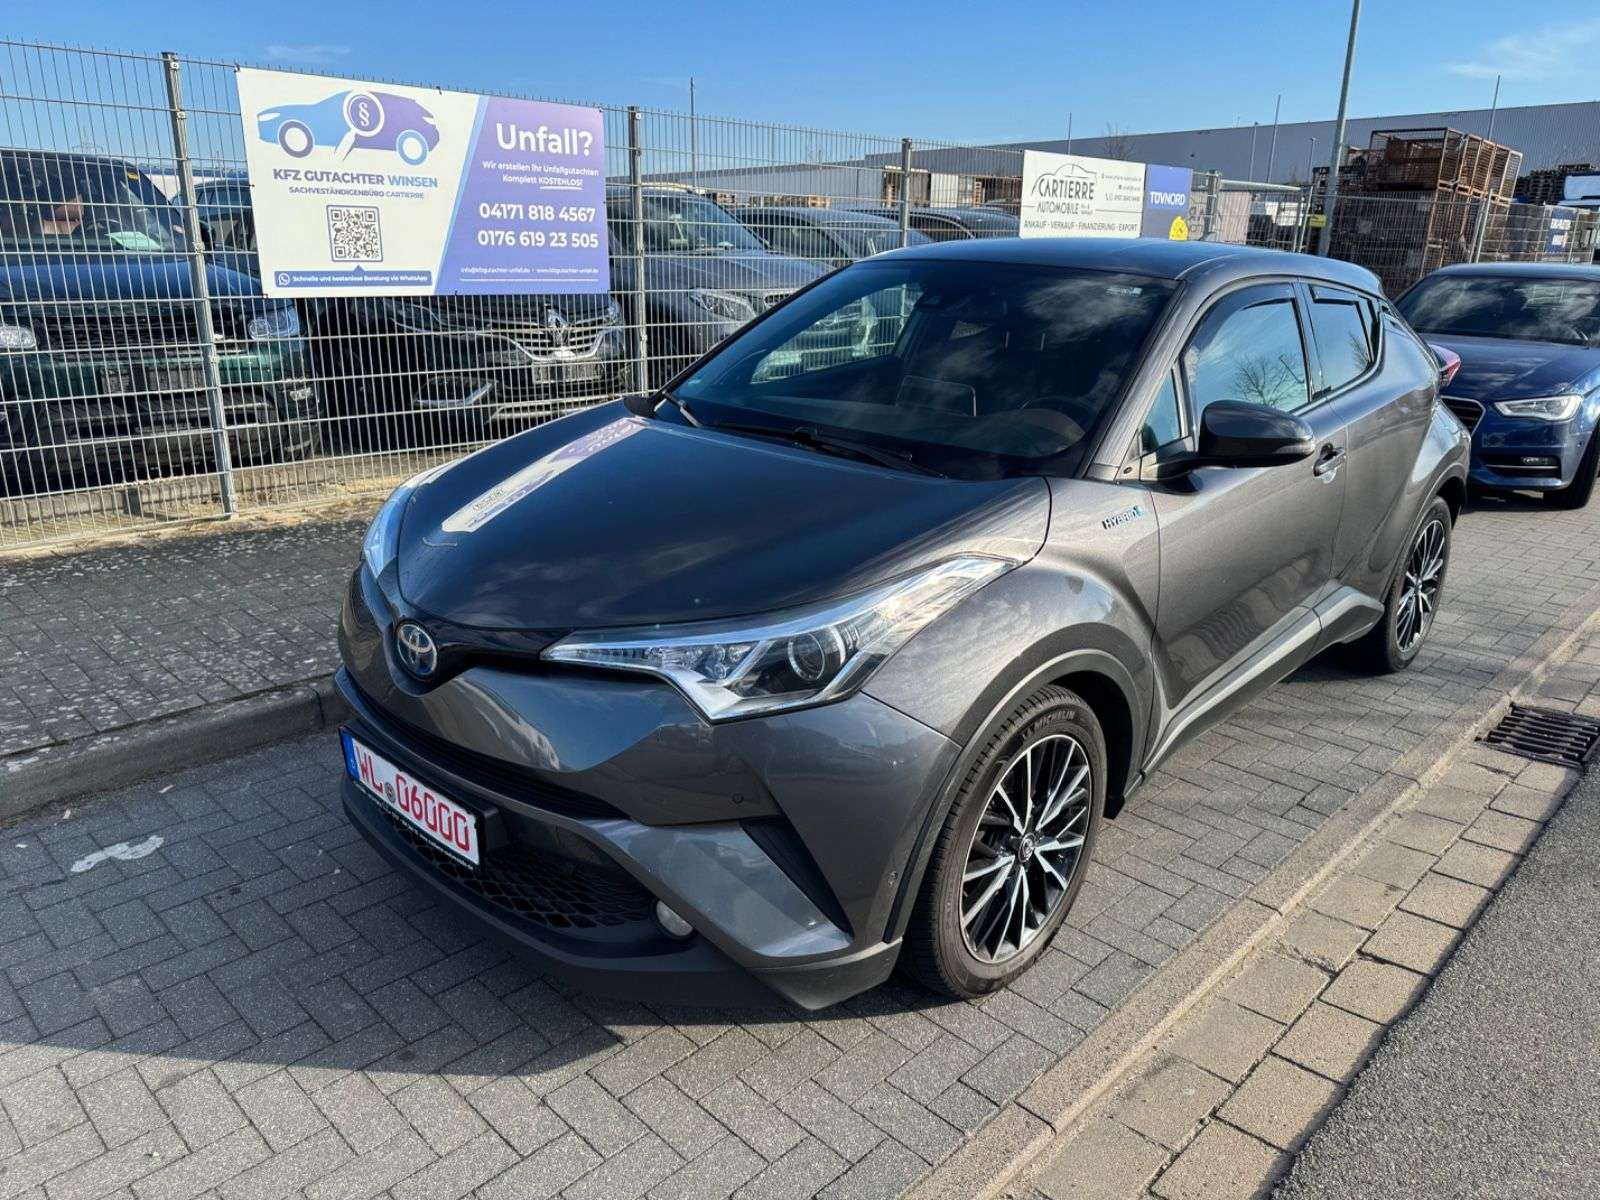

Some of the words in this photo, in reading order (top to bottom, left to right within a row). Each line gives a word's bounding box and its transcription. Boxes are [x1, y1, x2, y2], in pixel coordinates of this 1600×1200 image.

[496, 122, 593, 157] Unfall?
[482, 160, 496, 169] Wir
[498, 162, 530, 172] erstellen
[543, 165, 599, 176] Unfallgutachten
[273, 168, 301, 182] KFZ
[304, 171, 385, 186] GUTACHTER
[388, 174, 438, 188] WINSEN
[502, 174, 537, 184] Komplett
[289, 186, 384, 197] SACHVESTÄNDIGENBÜRO
[1038, 178, 1095, 200] CARTIERRE
[479, 202, 524, 219] 04171
[528, 204, 555, 220] 818
[559, 206, 596, 223] 4567
[1037, 201, 1079, 215] AUTOMOBILE
[1024, 220, 1047, 229] ANKAUF
[1051, 221, 1075, 230] VERKAUF
[1079, 222, 1115, 232] FINANZIERUNG
[1119, 223, 1138, 232] EXPORT
[478, 230, 515, 246] 0176
[519, 231, 545, 247] 619
[549, 232, 567, 247] 23
[571, 232, 598, 248] 505
[364, 275, 390, 283] Beratung
[356, 745, 384, 794] WL
[396, 773, 470, 852] 06000
